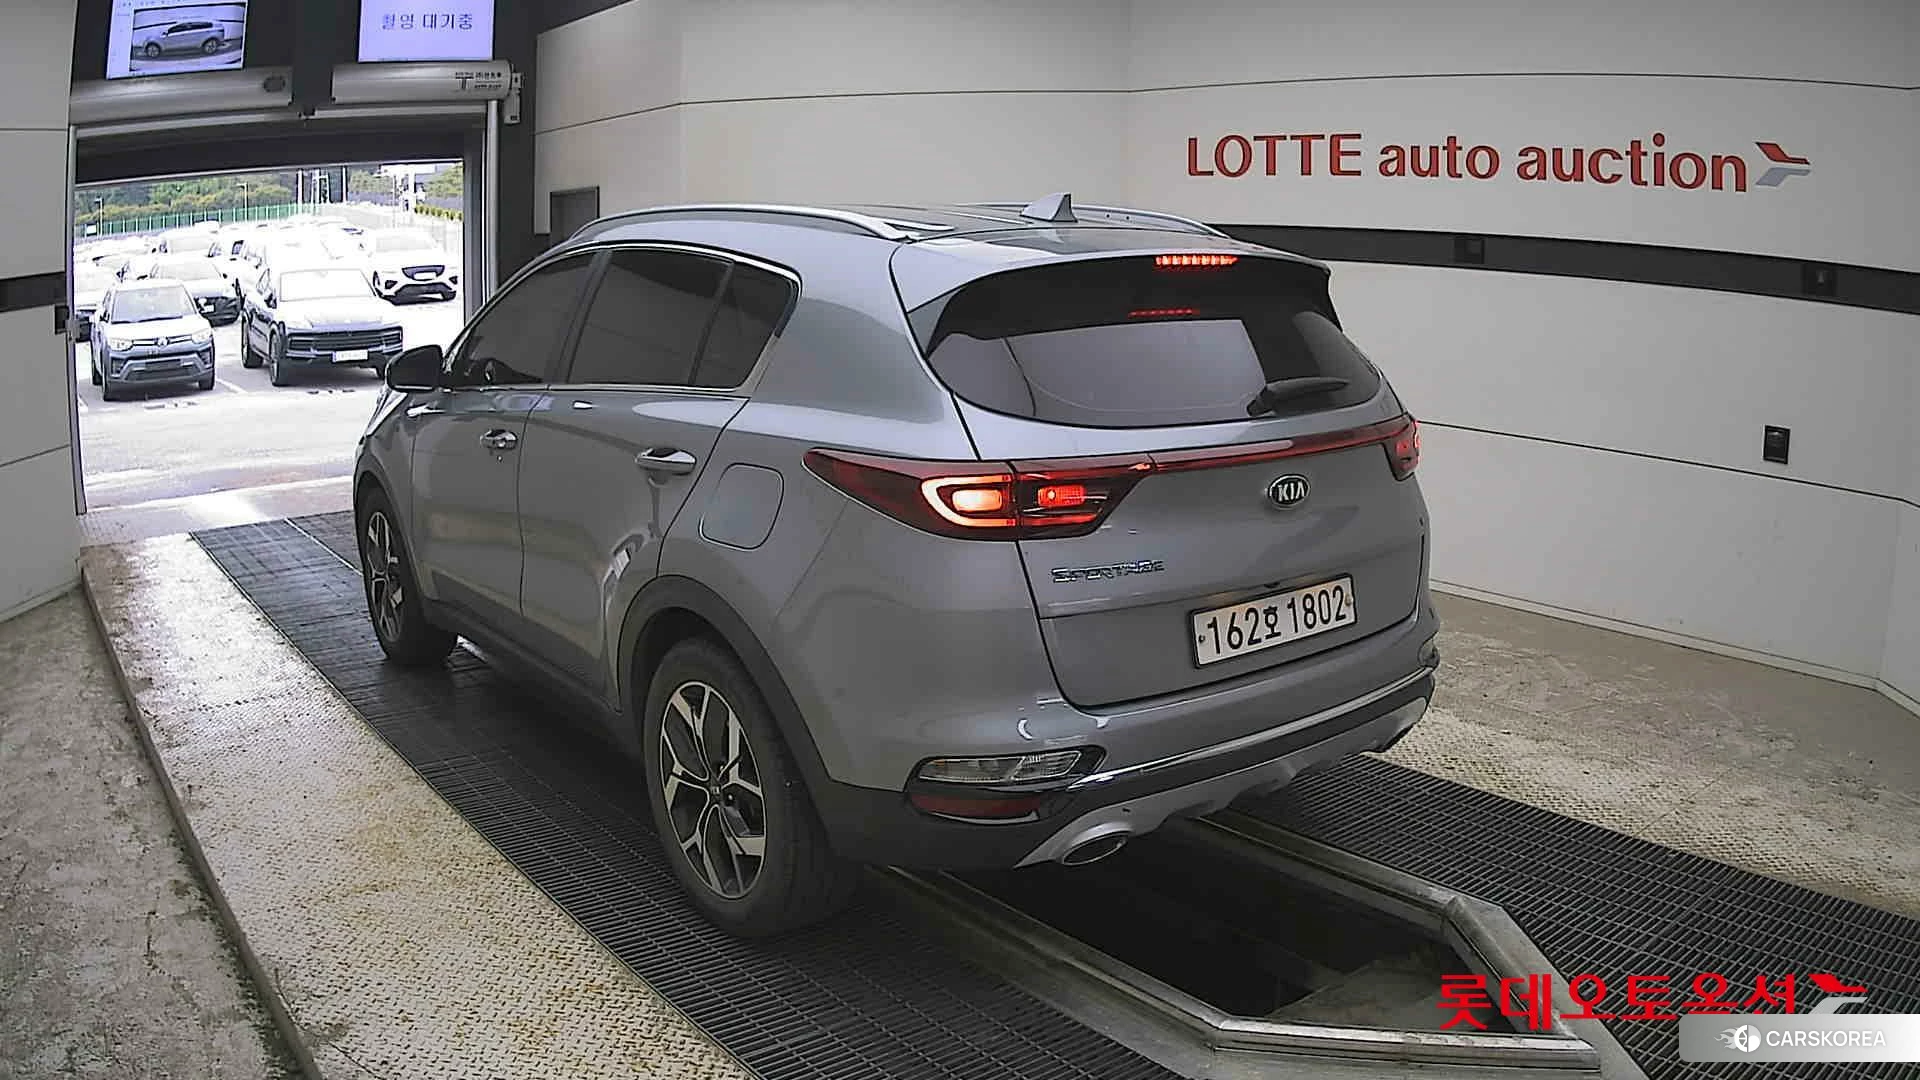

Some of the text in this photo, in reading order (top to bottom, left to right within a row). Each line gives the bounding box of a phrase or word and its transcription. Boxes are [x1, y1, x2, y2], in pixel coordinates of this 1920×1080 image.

[423, 13, 473, 30] 대기중
[1187, 132, 1747, 192] LOTTE auto auction
[1277, 481, 1305, 502] KIA
[1206, 585, 1347, 655] 162호 1802
